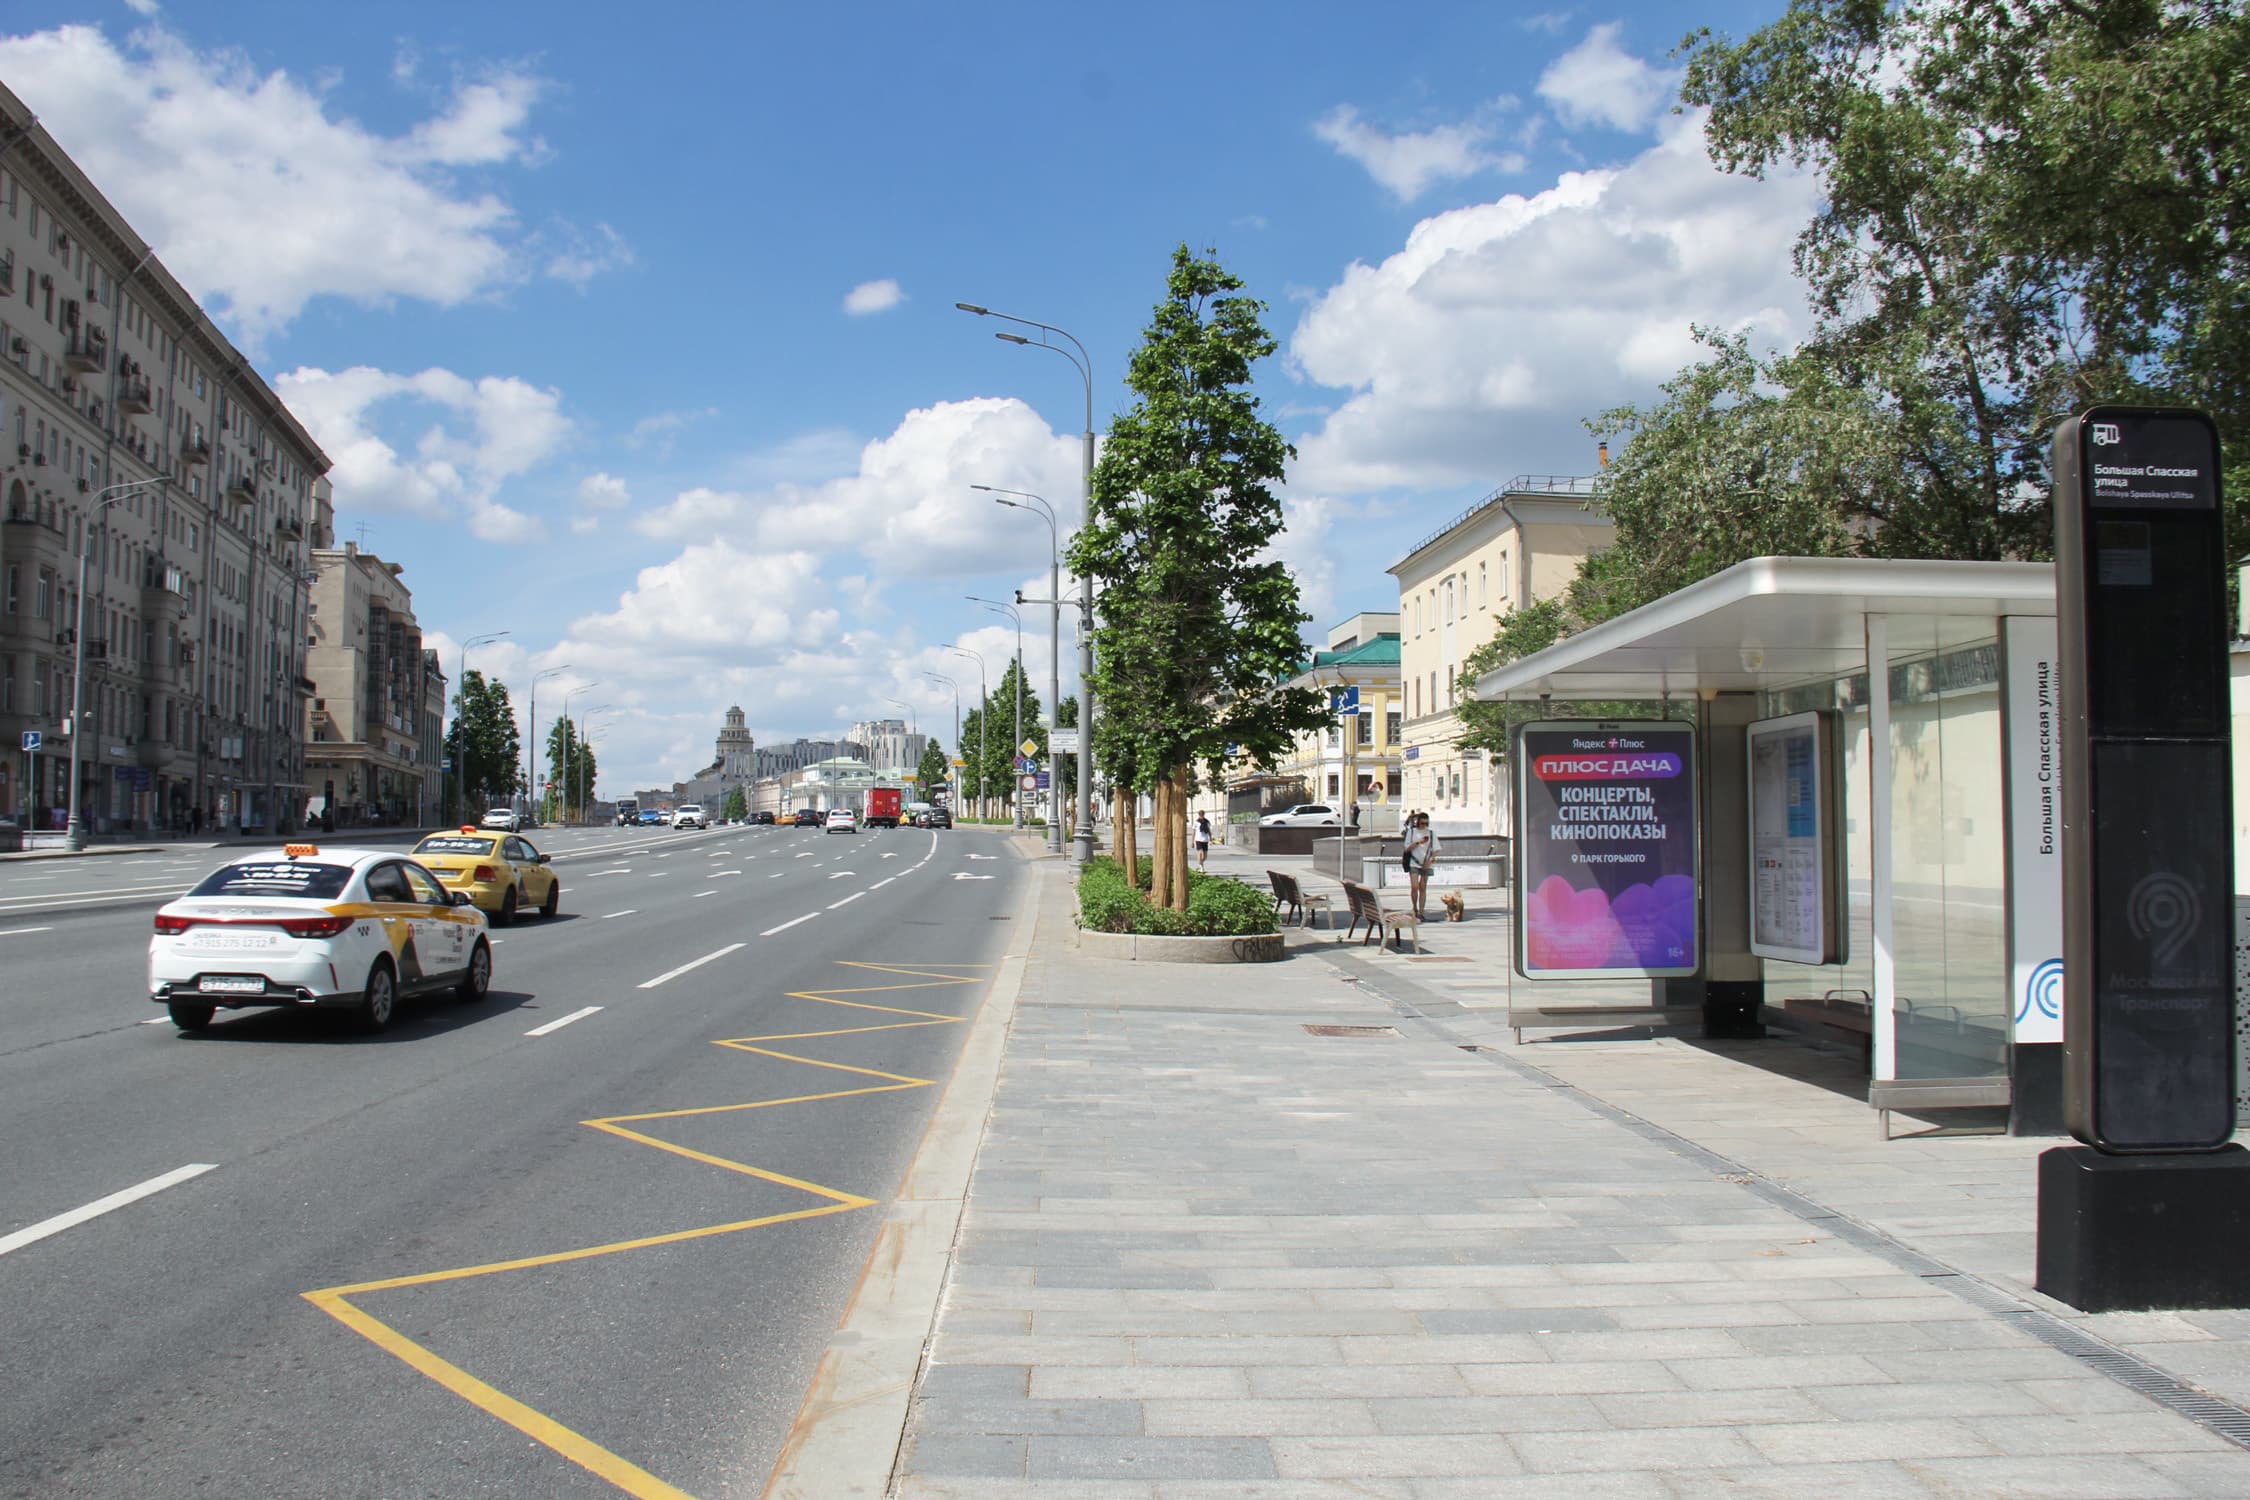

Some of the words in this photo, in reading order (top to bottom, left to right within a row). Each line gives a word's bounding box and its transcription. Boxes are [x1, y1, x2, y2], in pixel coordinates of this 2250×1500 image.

[2094, 464, 2144, 476] Большая
[2146, 466, 2198, 477] Спасская
[2094, 478, 2128, 488] улица
[2037, 661, 2052, 707] улица
[1572, 738, 1606, 749] Яндекс
[1619, 738, 1645, 748] Плюс
[2038, 711, 2051, 782] Спасская
[1542, 760, 1608, 773] ПЛЮС
[1611, 759, 1672, 775] ДАЧА
[1561, 787, 1655, 805] КОНЦЕРТЫ,
[1559, 806, 1658, 823] СПЕКТАКЛИ,
[2040, 786, 2053, 855] Большая
[1551, 824, 1666, 840] КИНОПОКАЗЫ
[1580, 854, 1602, 864] ПАРК
[1604, 854, 1646, 863] ГОРЬКОГО
